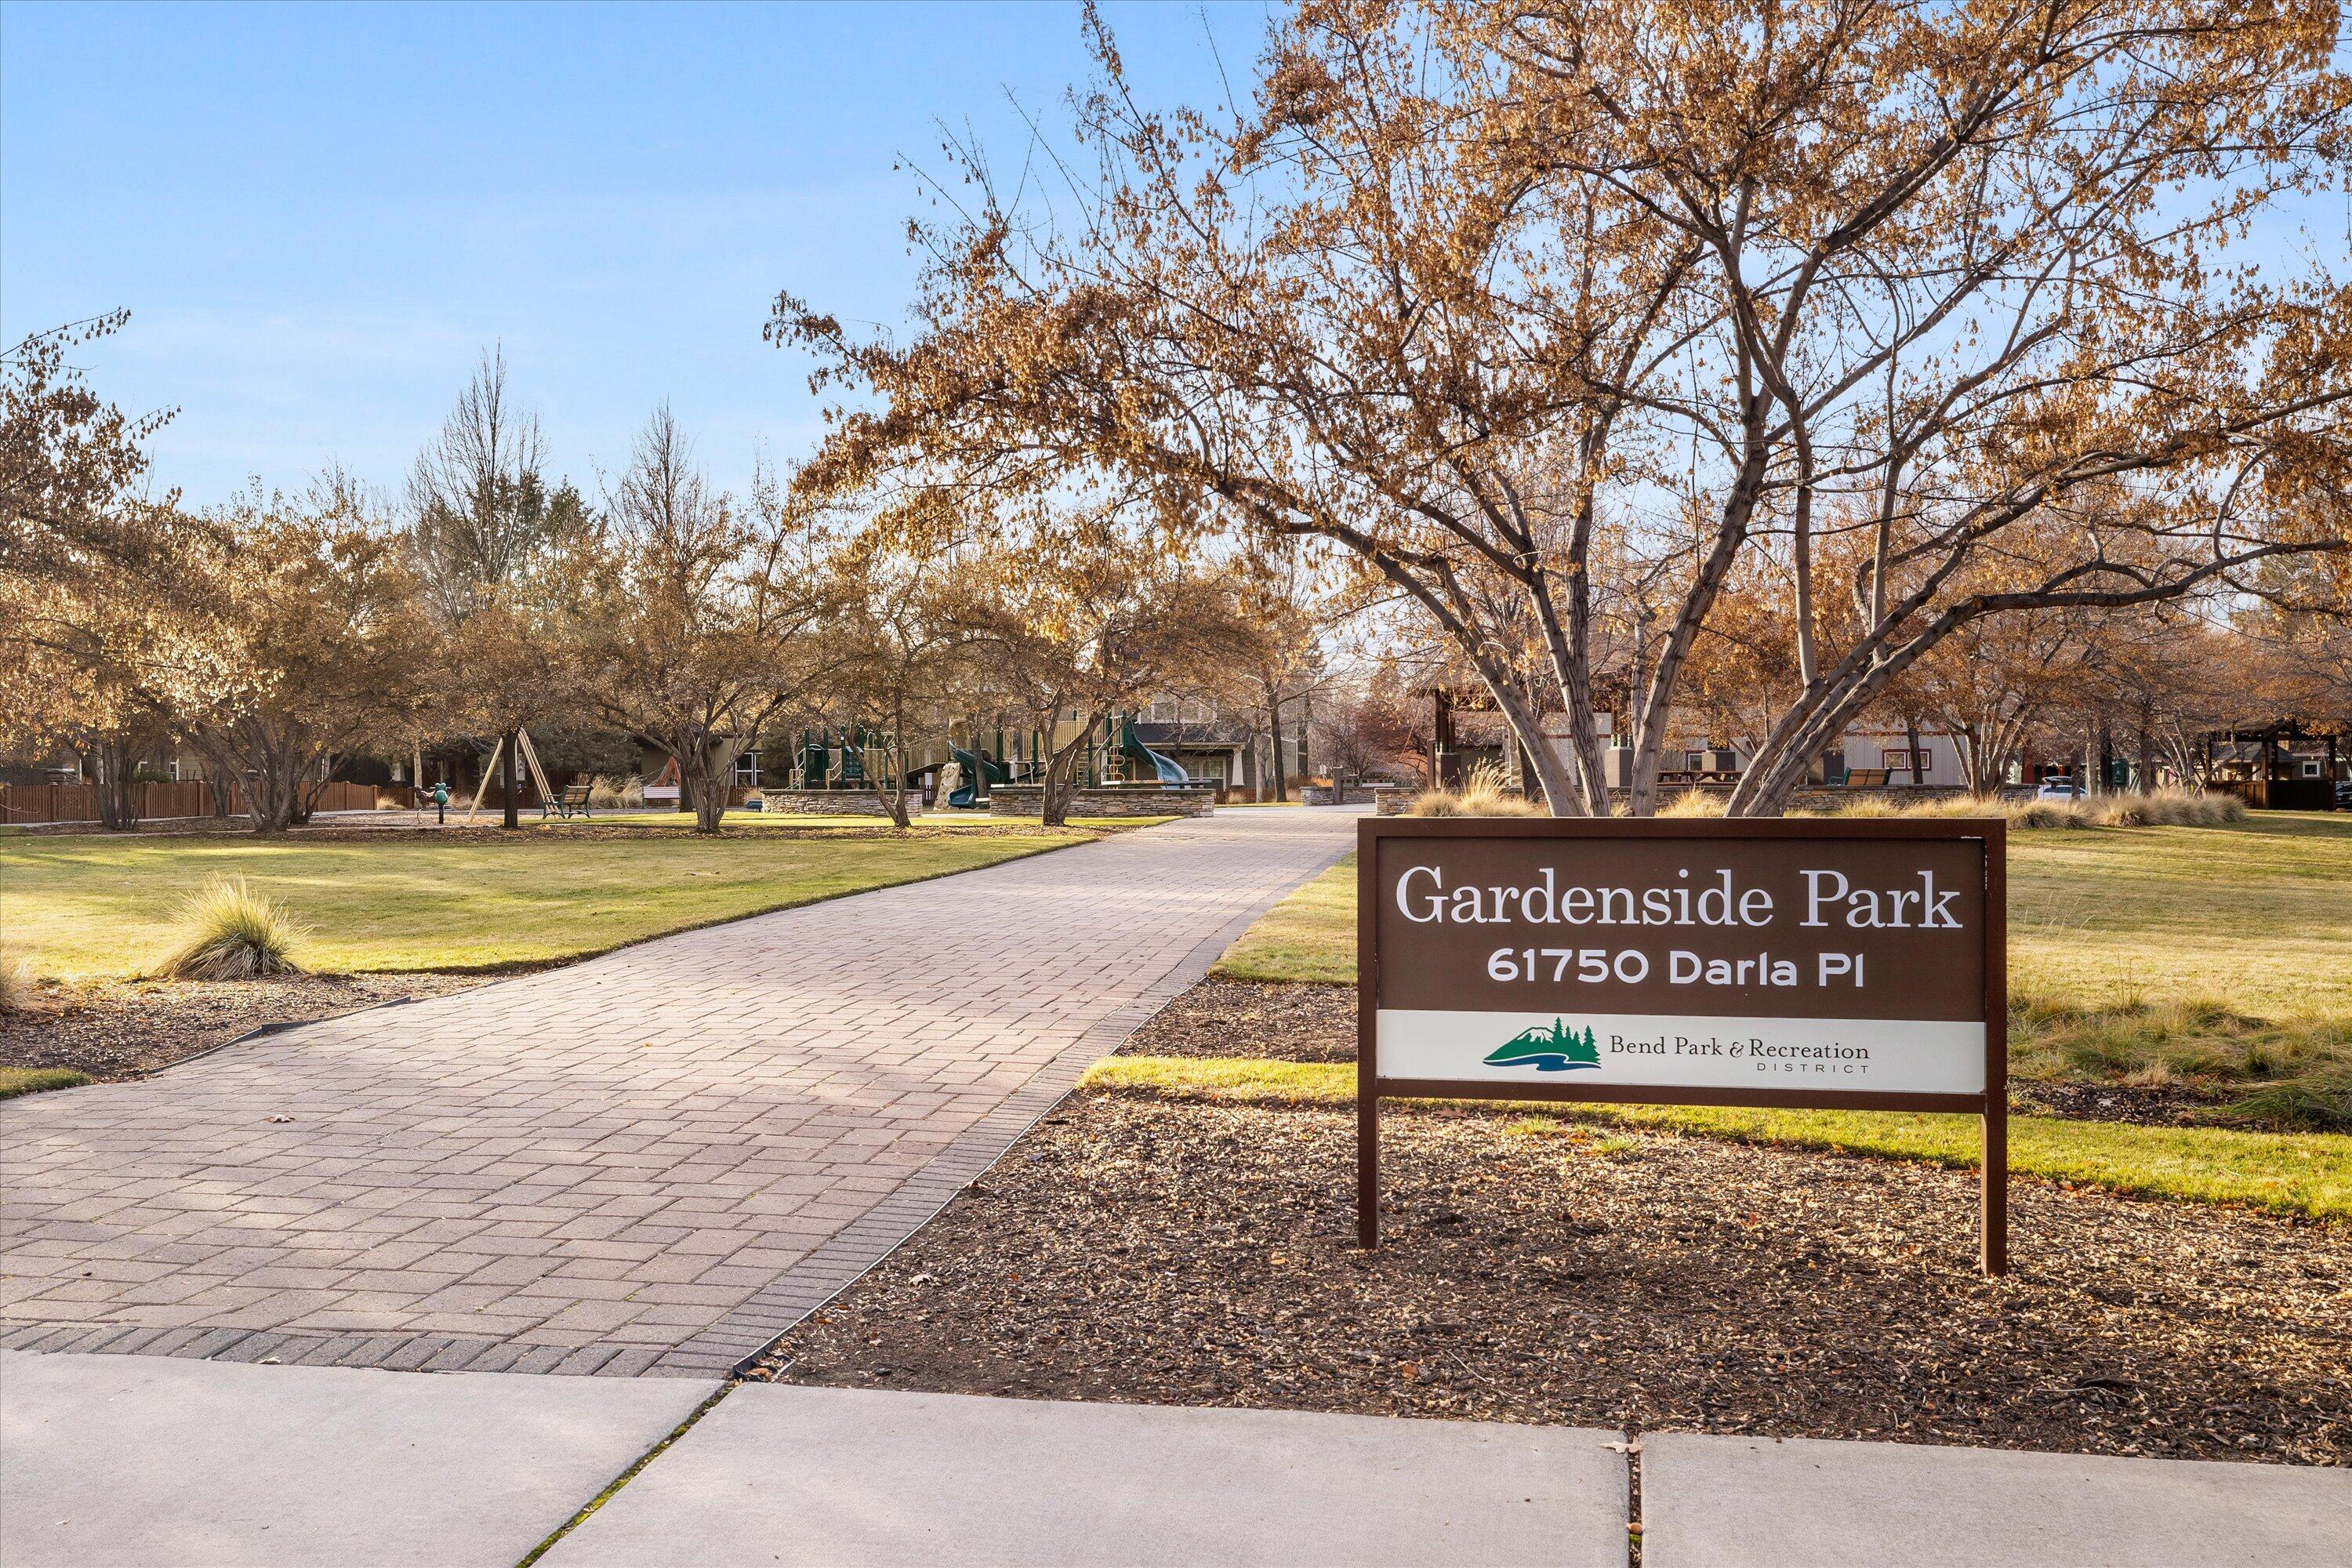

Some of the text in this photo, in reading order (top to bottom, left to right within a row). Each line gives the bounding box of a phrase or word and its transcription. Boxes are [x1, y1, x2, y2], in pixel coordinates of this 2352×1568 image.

[1396, 866, 1963, 928] Gardenside Park
[1487, 947, 1864, 987] 61750 Darla Pl
[1610, 1035, 1871, 1059] Bend Park & Recreation
[1757, 1062, 1869, 1074] DISTRICT
